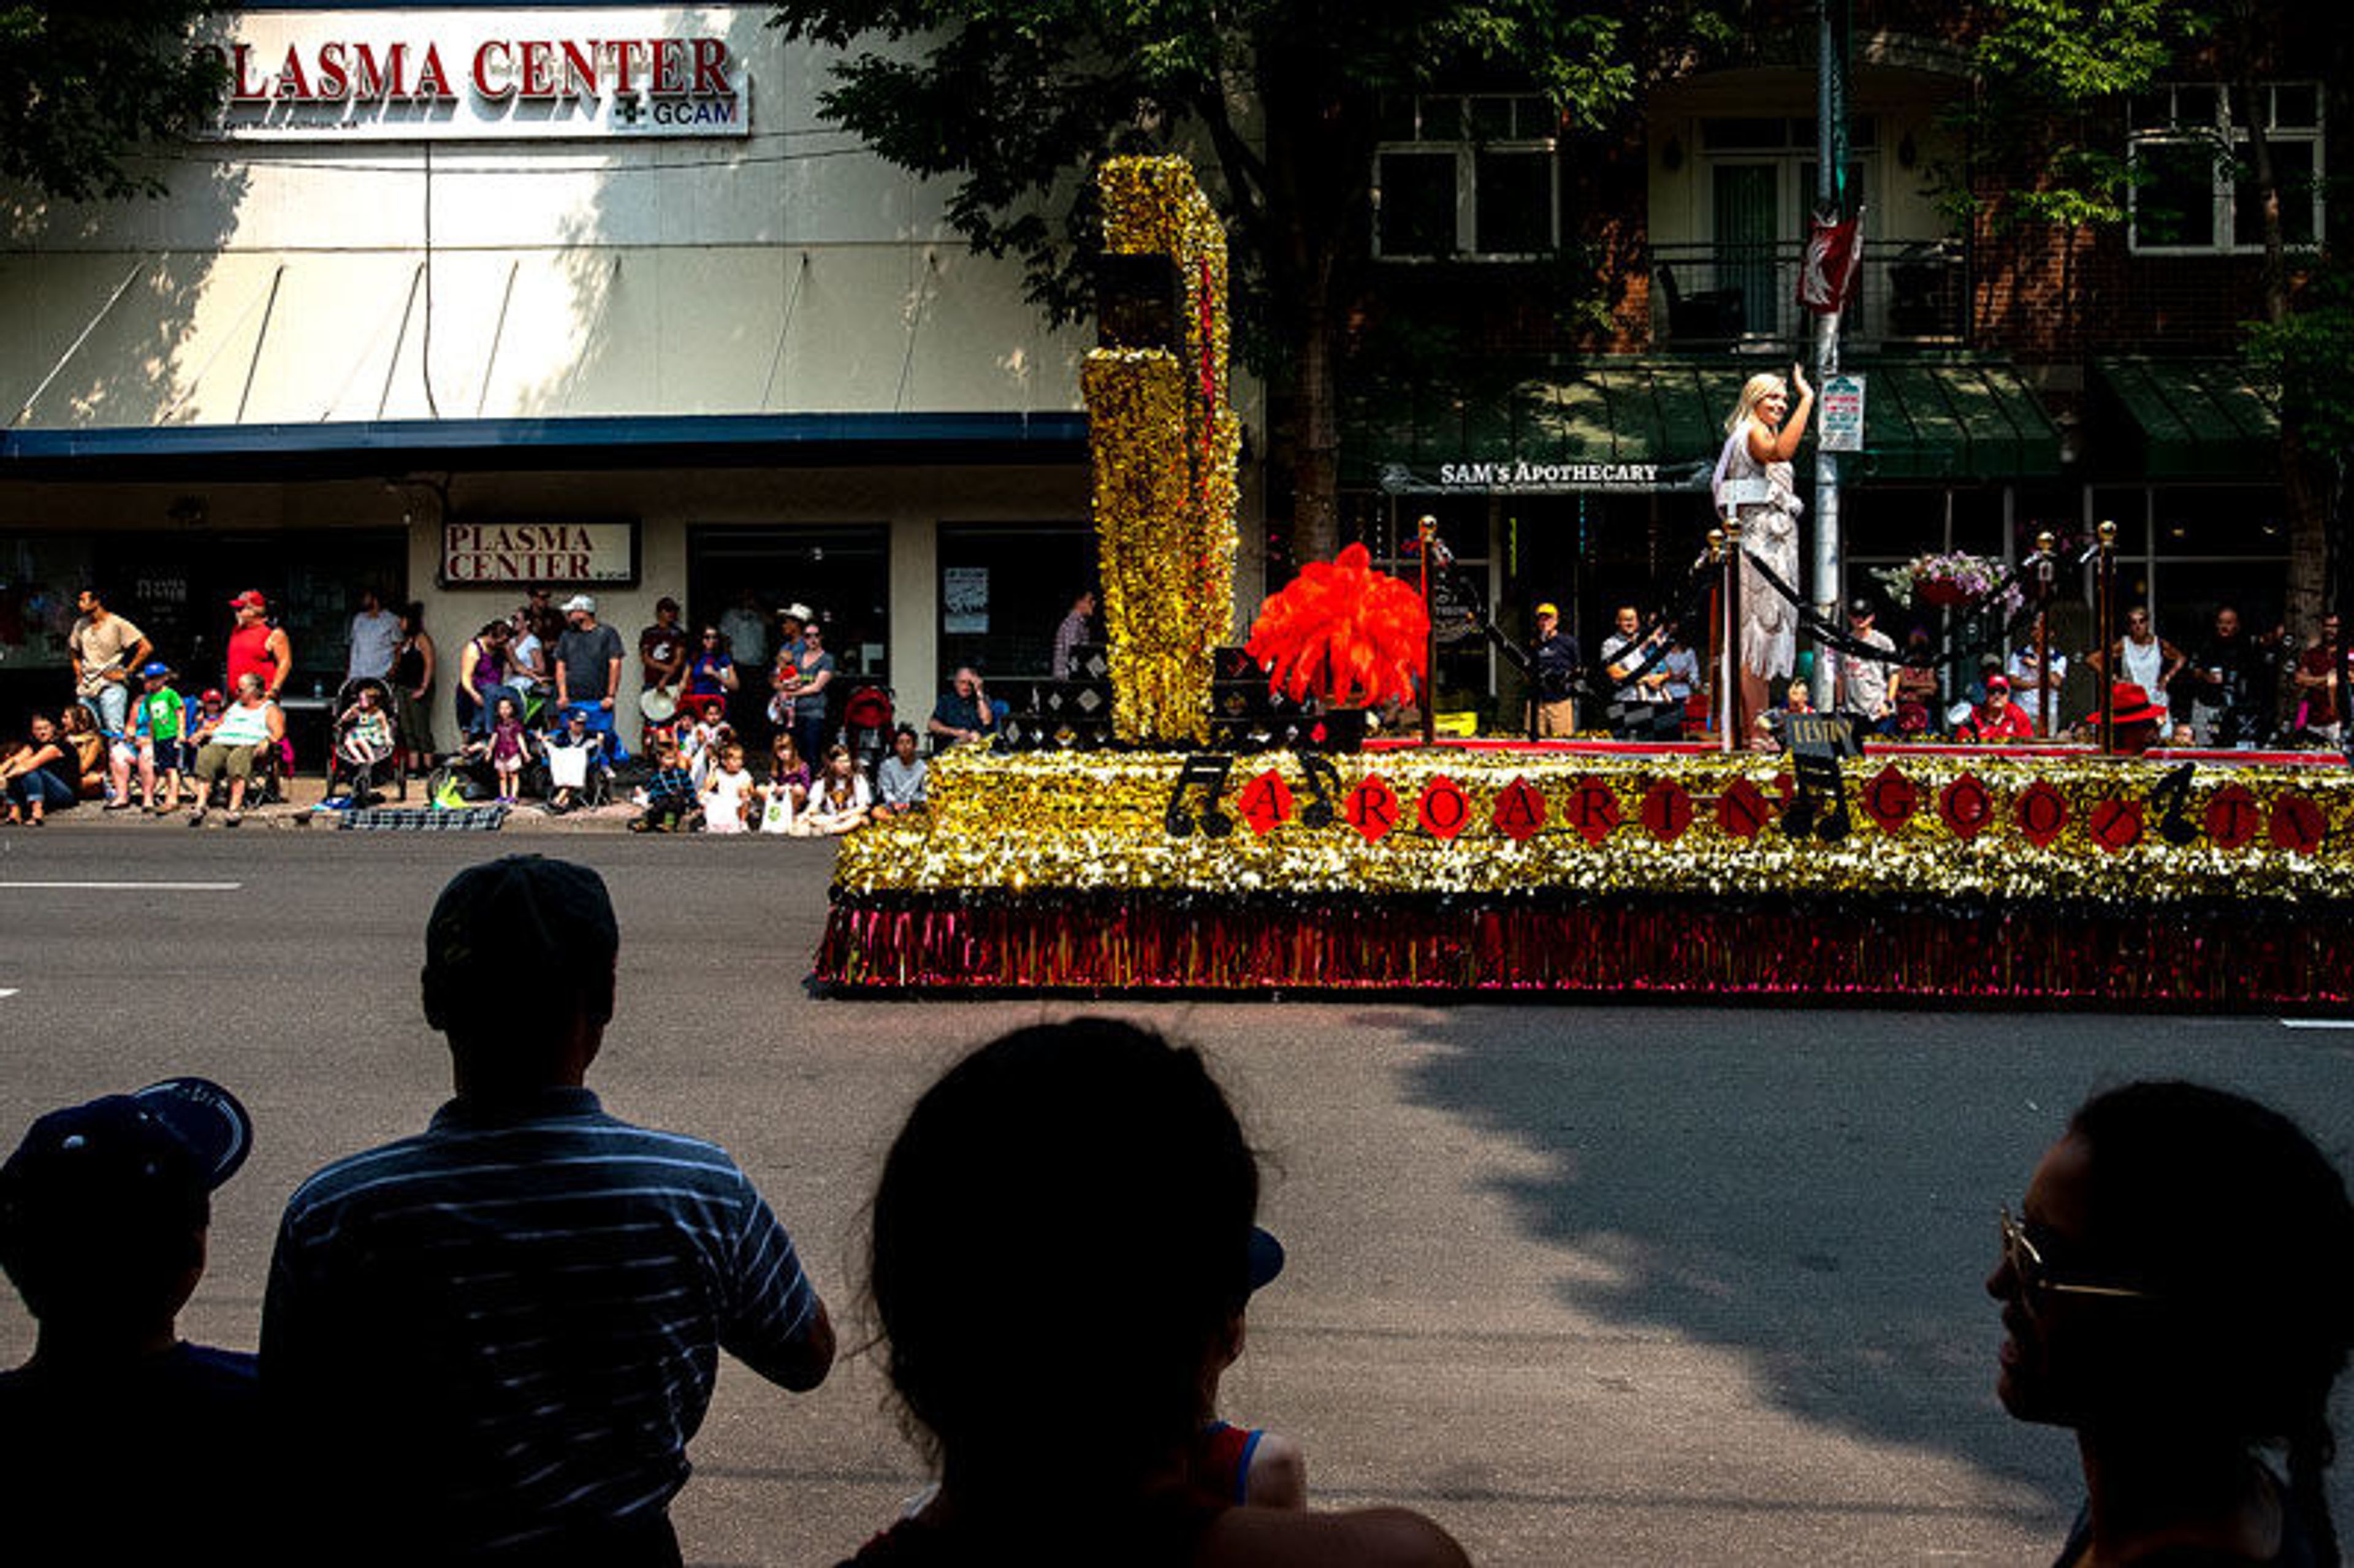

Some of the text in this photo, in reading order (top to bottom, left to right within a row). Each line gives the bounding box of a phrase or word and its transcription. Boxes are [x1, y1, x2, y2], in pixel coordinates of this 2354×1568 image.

[473, 38, 734, 96] CENTER
[653, 101, 737, 124] GCAM
[448, 526, 593, 551] PLASMA
[448, 554, 590, 578] CENTER
[1245, 777, 1282, 822] A
[1874, 778, 2140, 847] GOOD
